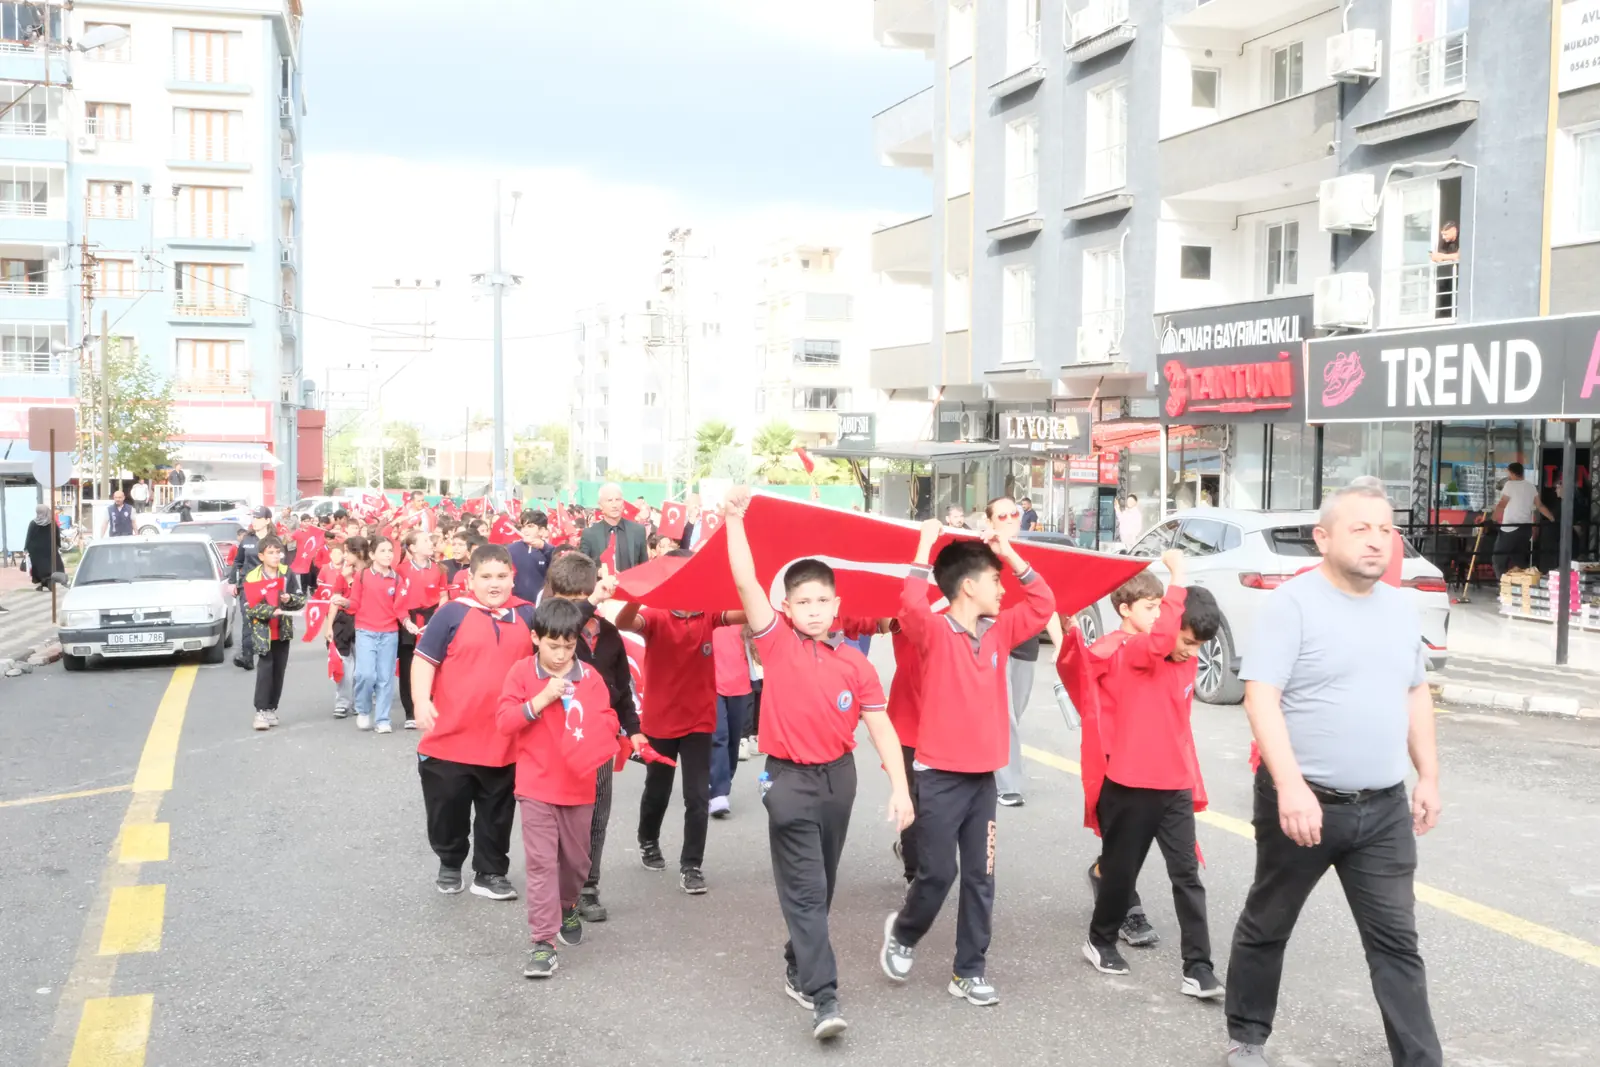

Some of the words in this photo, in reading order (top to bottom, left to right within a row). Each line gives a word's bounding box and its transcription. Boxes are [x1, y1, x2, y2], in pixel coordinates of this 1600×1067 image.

[1569, 59, 1590, 72] 0545
[1381, 339, 1541, 407] TREND
[1006, 416, 1073, 440] LEVORA
[114, 635, 124, 643] 06
[129, 634, 144, 643] EMJ
[148, 633, 163, 641] 786
